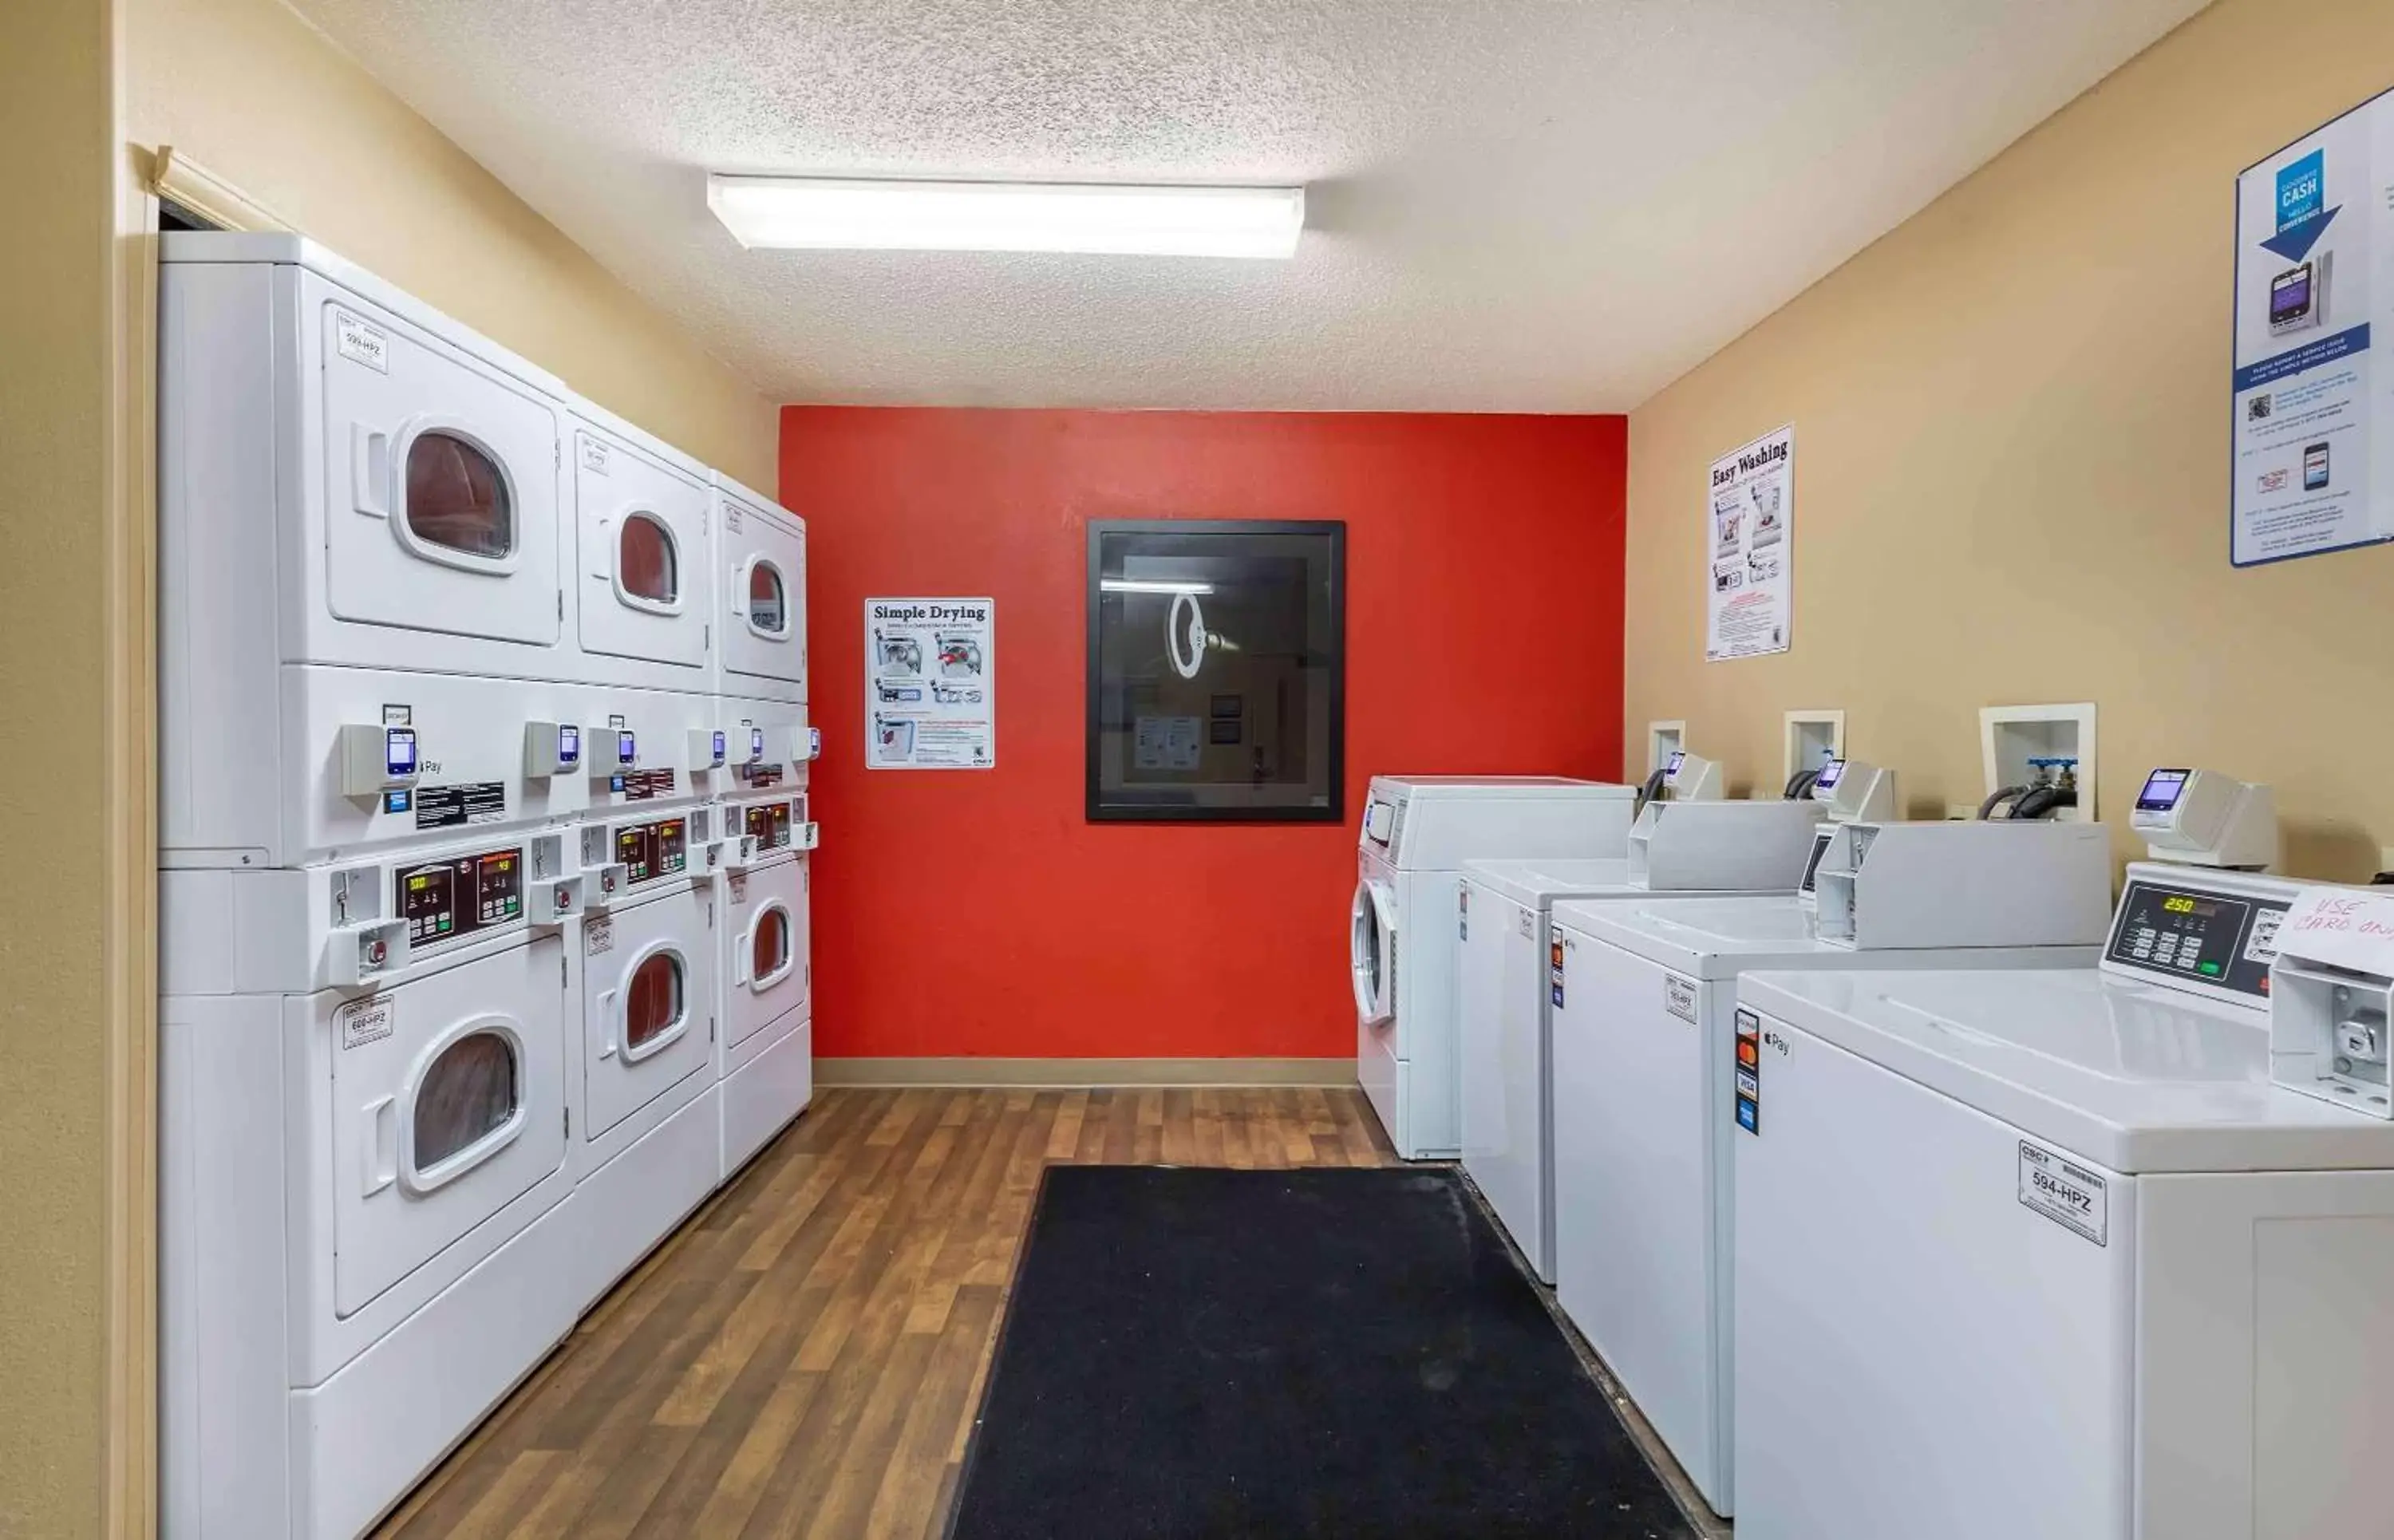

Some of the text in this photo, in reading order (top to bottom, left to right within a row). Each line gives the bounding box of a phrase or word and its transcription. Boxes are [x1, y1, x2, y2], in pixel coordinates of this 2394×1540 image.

[2282, 178, 2317, 207] CASH
[1713, 465, 1736, 487] Easy
[1738, 441, 1788, 474] Washing
[874, 606, 986, 622] Simple Drying
[425, 760, 441, 774] Pay
[2164, 898, 2194, 912] 250
[2315, 897, 2368, 915] USE
[2293, 914, 2350, 930] CARD
[1772, 1033, 1790, 1056] Pay
[1740, 1076, 1755, 1092] VISA
[2021, 1145, 2043, 1162] CSC
[2033, 1171, 2092, 1213] 594-HPZ
